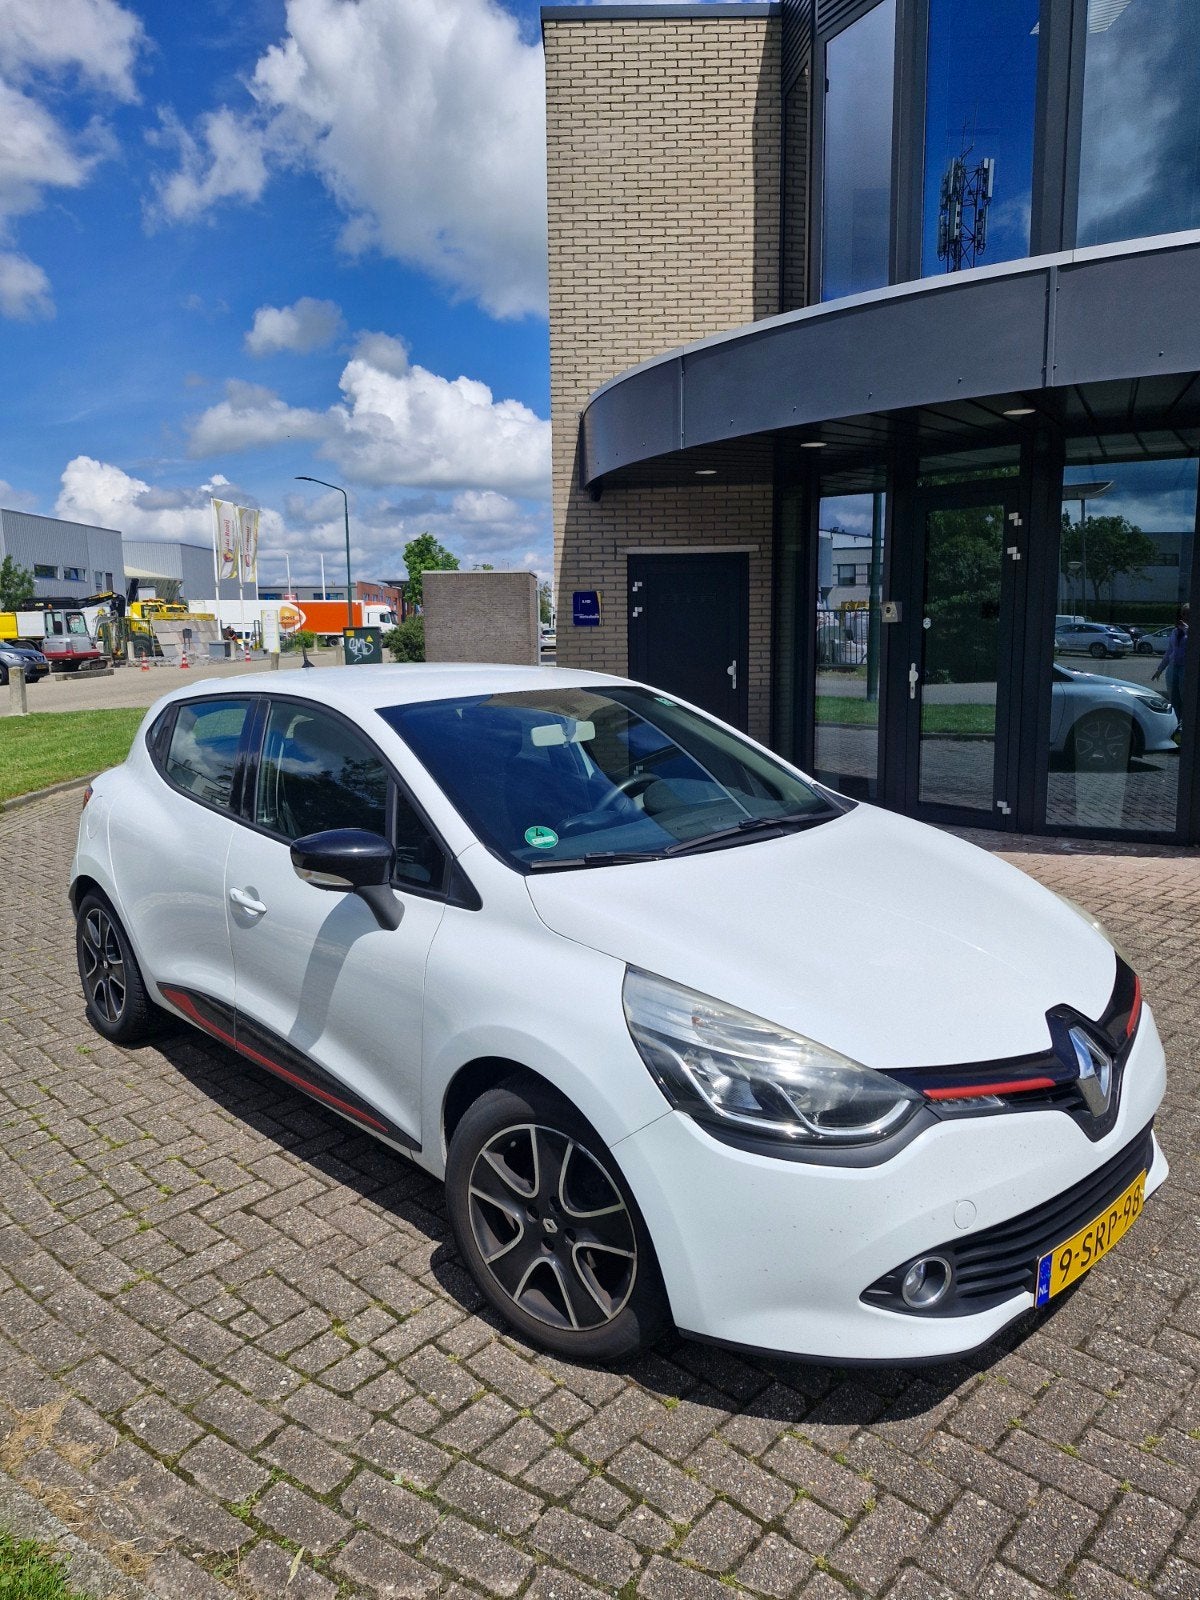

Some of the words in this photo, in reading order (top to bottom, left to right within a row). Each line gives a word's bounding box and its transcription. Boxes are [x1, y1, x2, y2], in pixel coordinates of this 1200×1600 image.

[535, 827, 545, 838] 4
[1059, 1184, 1142, 1283] 9-SRP-98
[1038, 1284, 1048, 1297] NL
